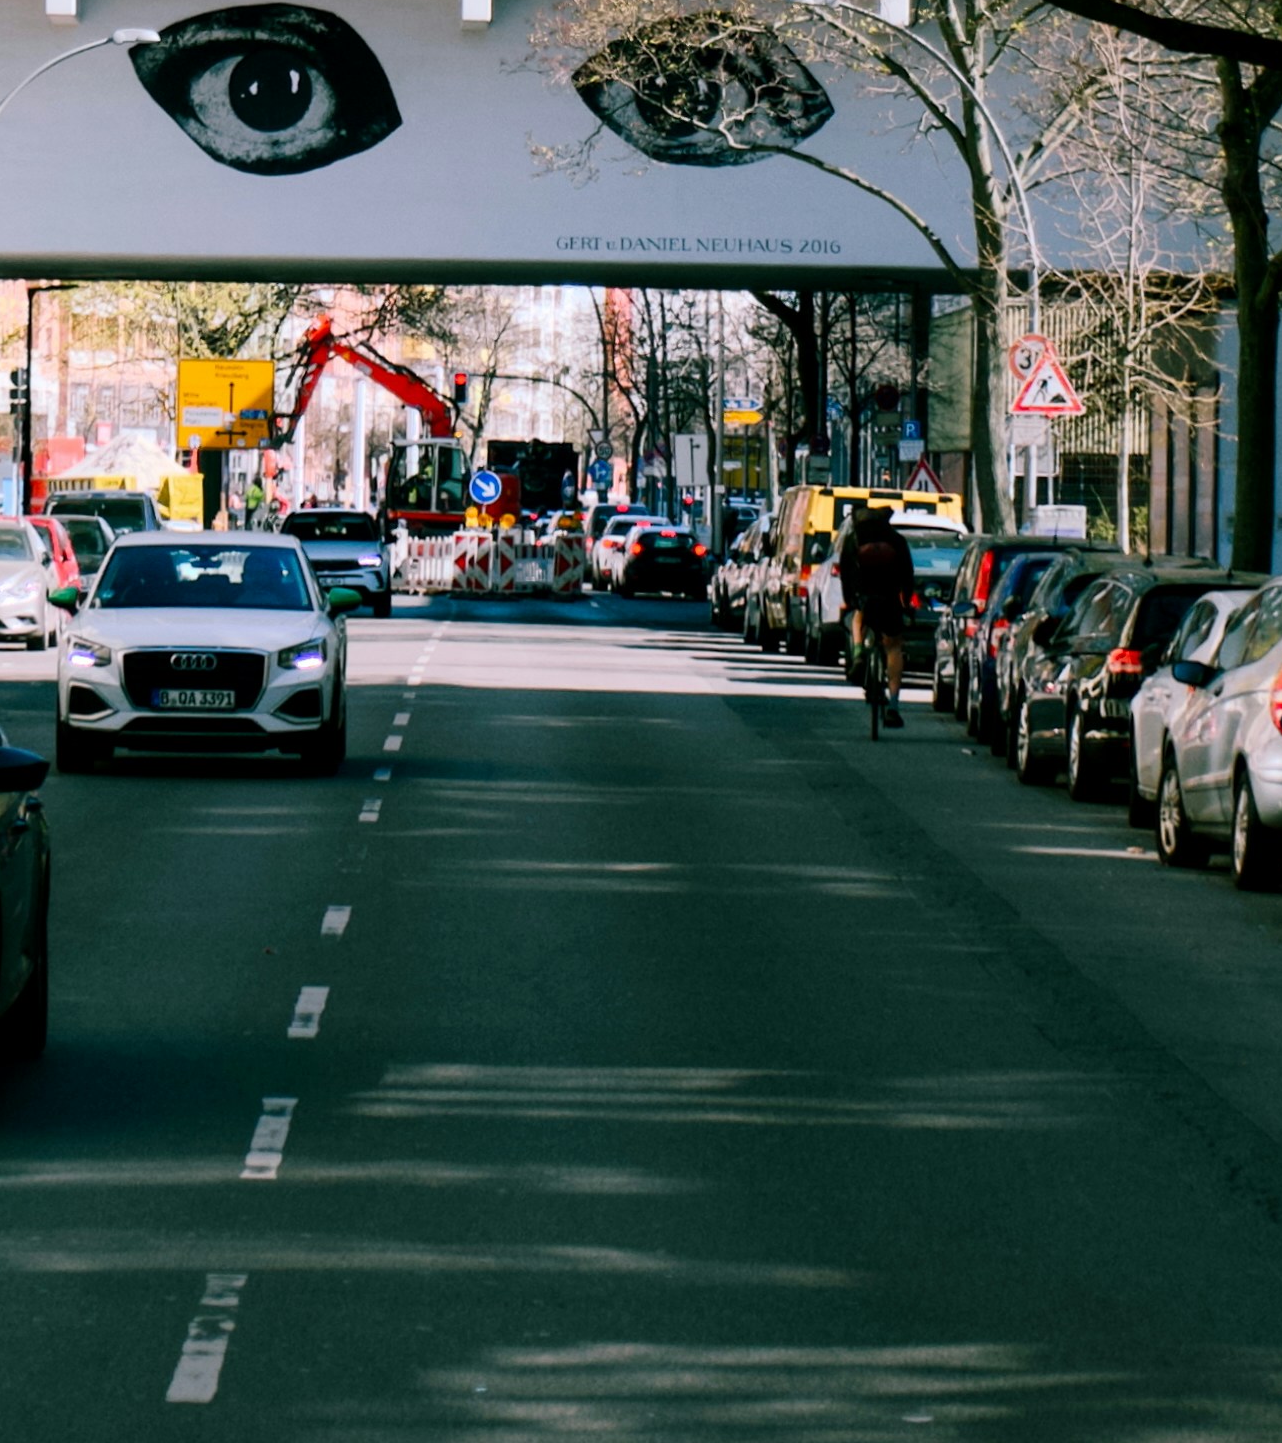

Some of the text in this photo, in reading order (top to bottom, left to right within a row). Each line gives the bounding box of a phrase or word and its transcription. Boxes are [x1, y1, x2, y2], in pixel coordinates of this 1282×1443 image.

[556, 237, 601, 251] GERT
[620, 237, 691, 252] DANIEL
[696, 238, 793, 254] NEUHAUS
[799, 239, 841, 254] 2016
[200, 693, 232, 705] 3391
